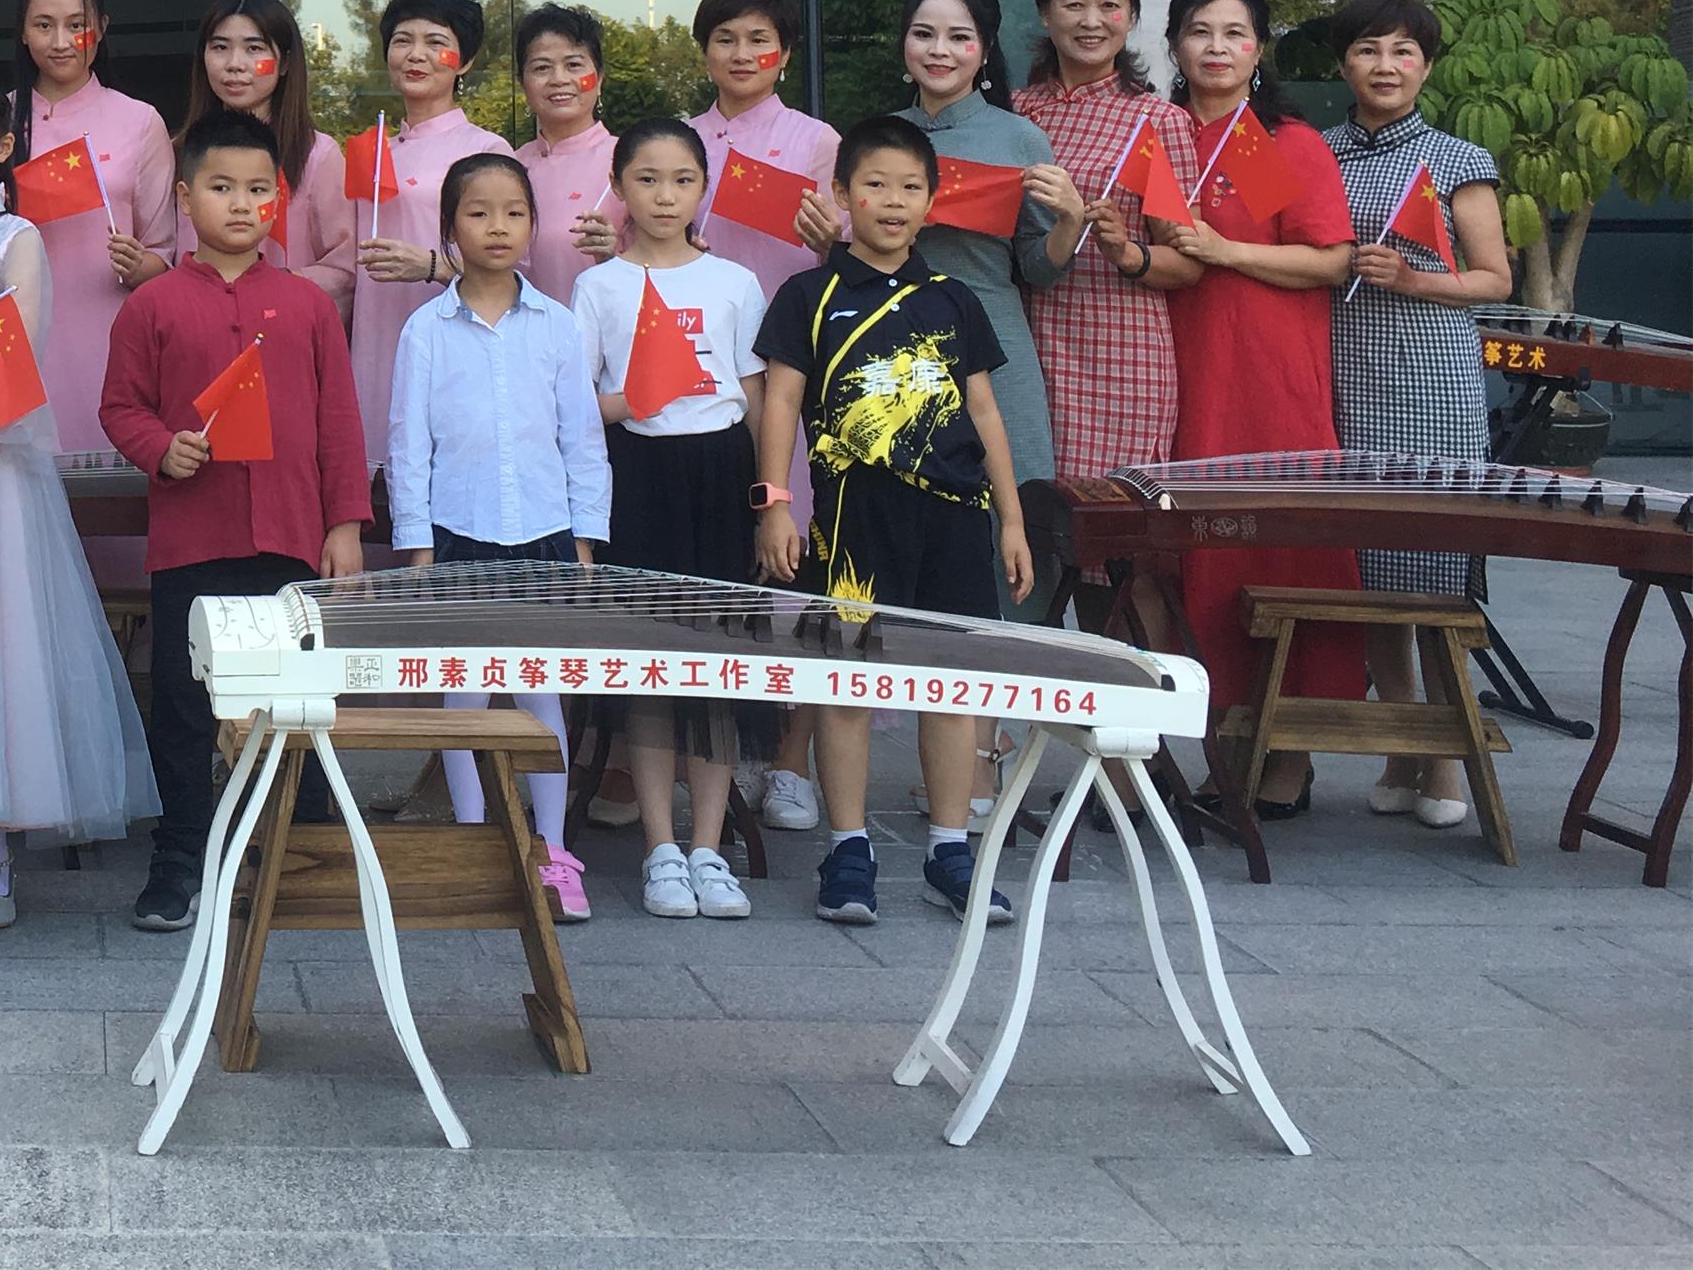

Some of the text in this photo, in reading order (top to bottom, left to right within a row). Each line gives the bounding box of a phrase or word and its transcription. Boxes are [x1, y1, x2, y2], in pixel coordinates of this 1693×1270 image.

[1483, 341, 1547, 371] 筝艺术
[397, 656, 1097, 716] 邢素贞筝琴艺术工作室 15819277164
